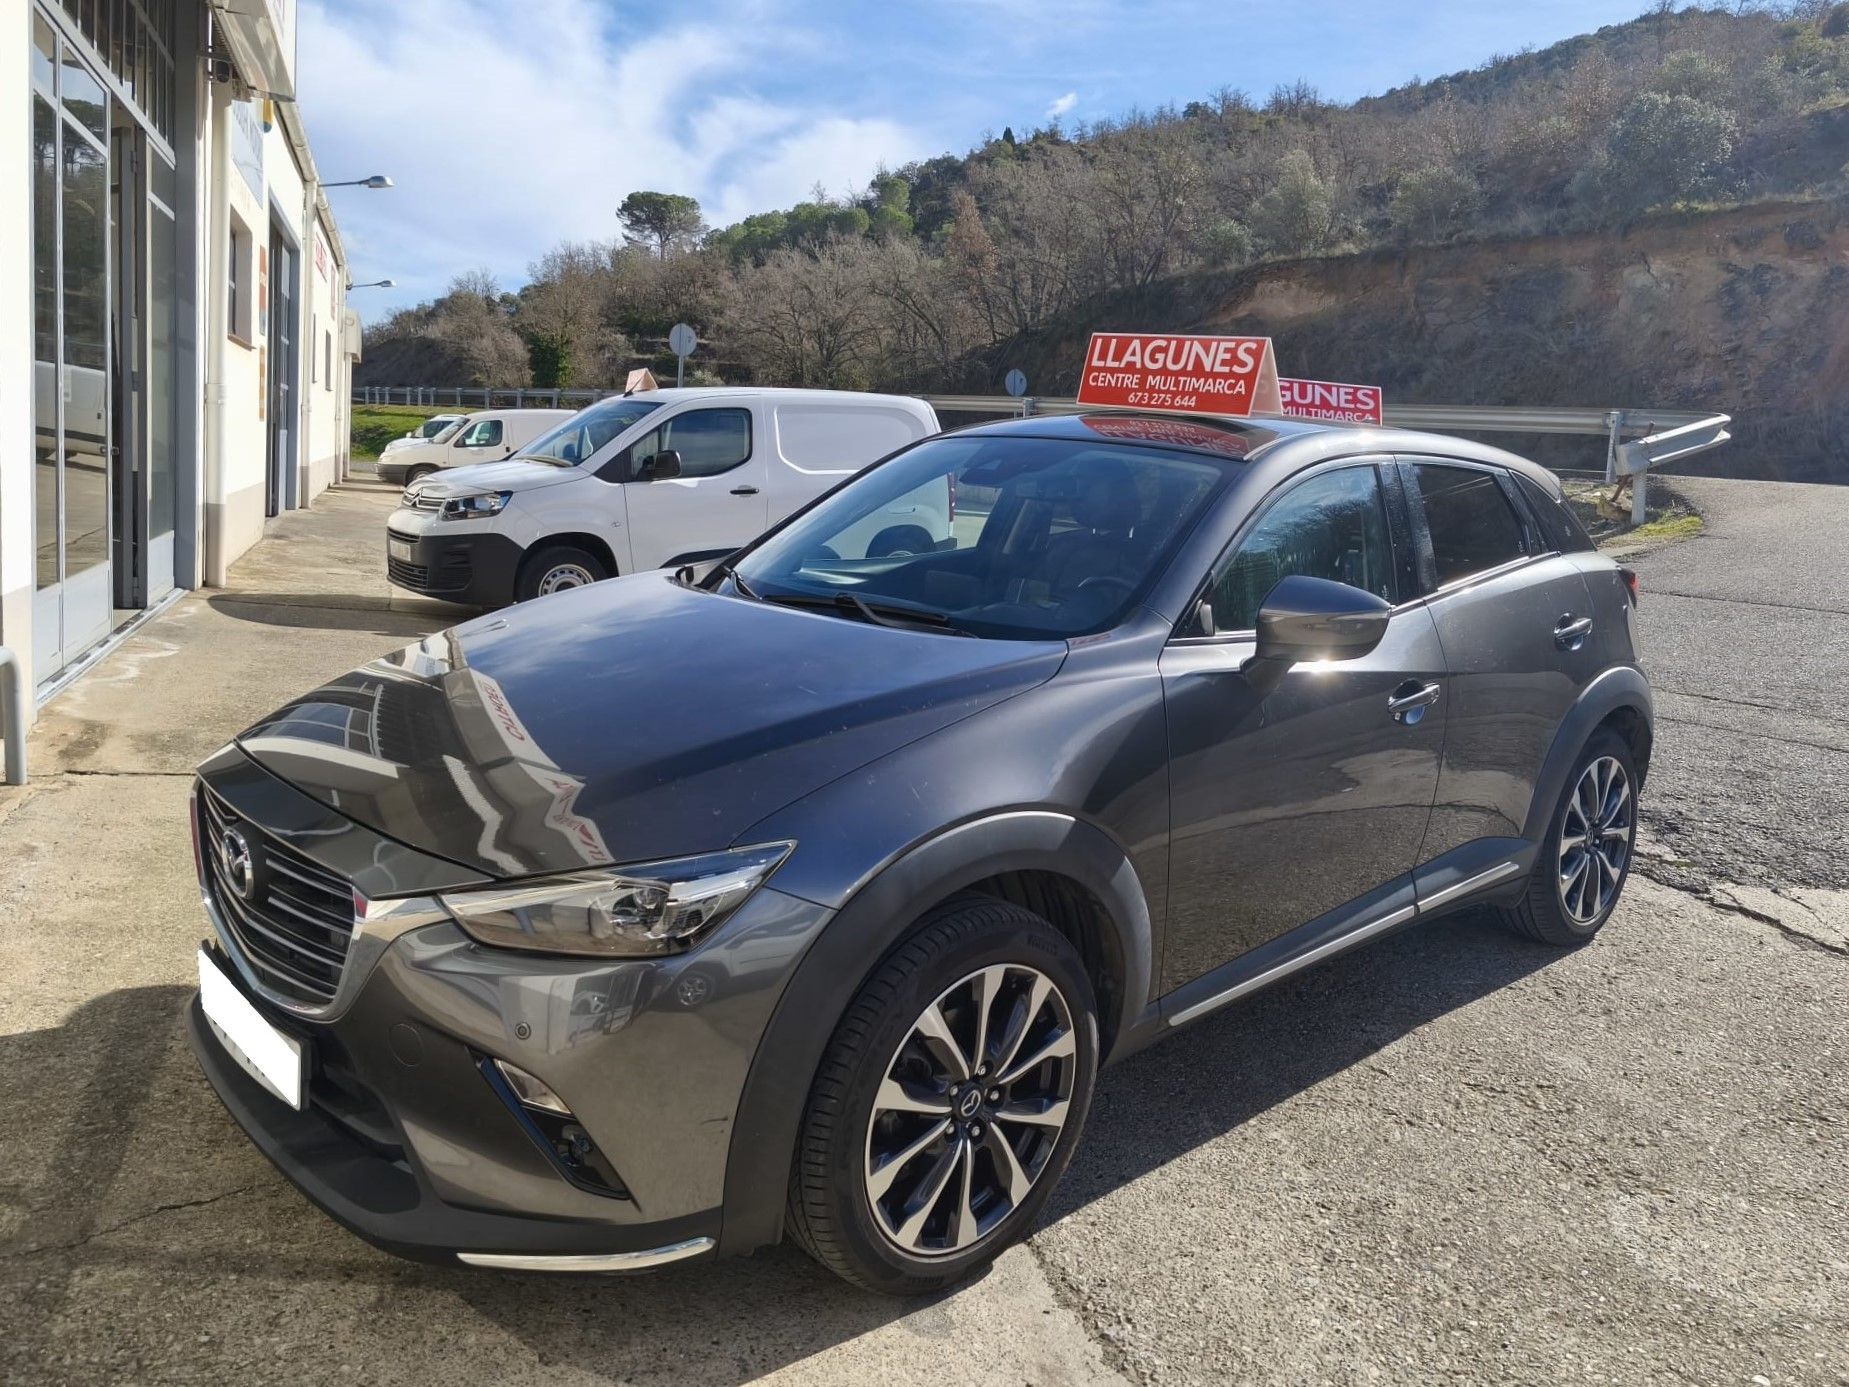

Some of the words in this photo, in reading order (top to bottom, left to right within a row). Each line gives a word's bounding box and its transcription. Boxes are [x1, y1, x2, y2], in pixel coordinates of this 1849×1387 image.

[1091, 338, 1258, 374] LLAGUNES
[1088, 372, 1141, 389] CENTRE
[1146, 375, 1246, 395] MULTIMARCA
[1128, 392, 1149, 404] 673
[1150, 393, 1172, 406] 275
[1174, 395, 1197, 408] 644
